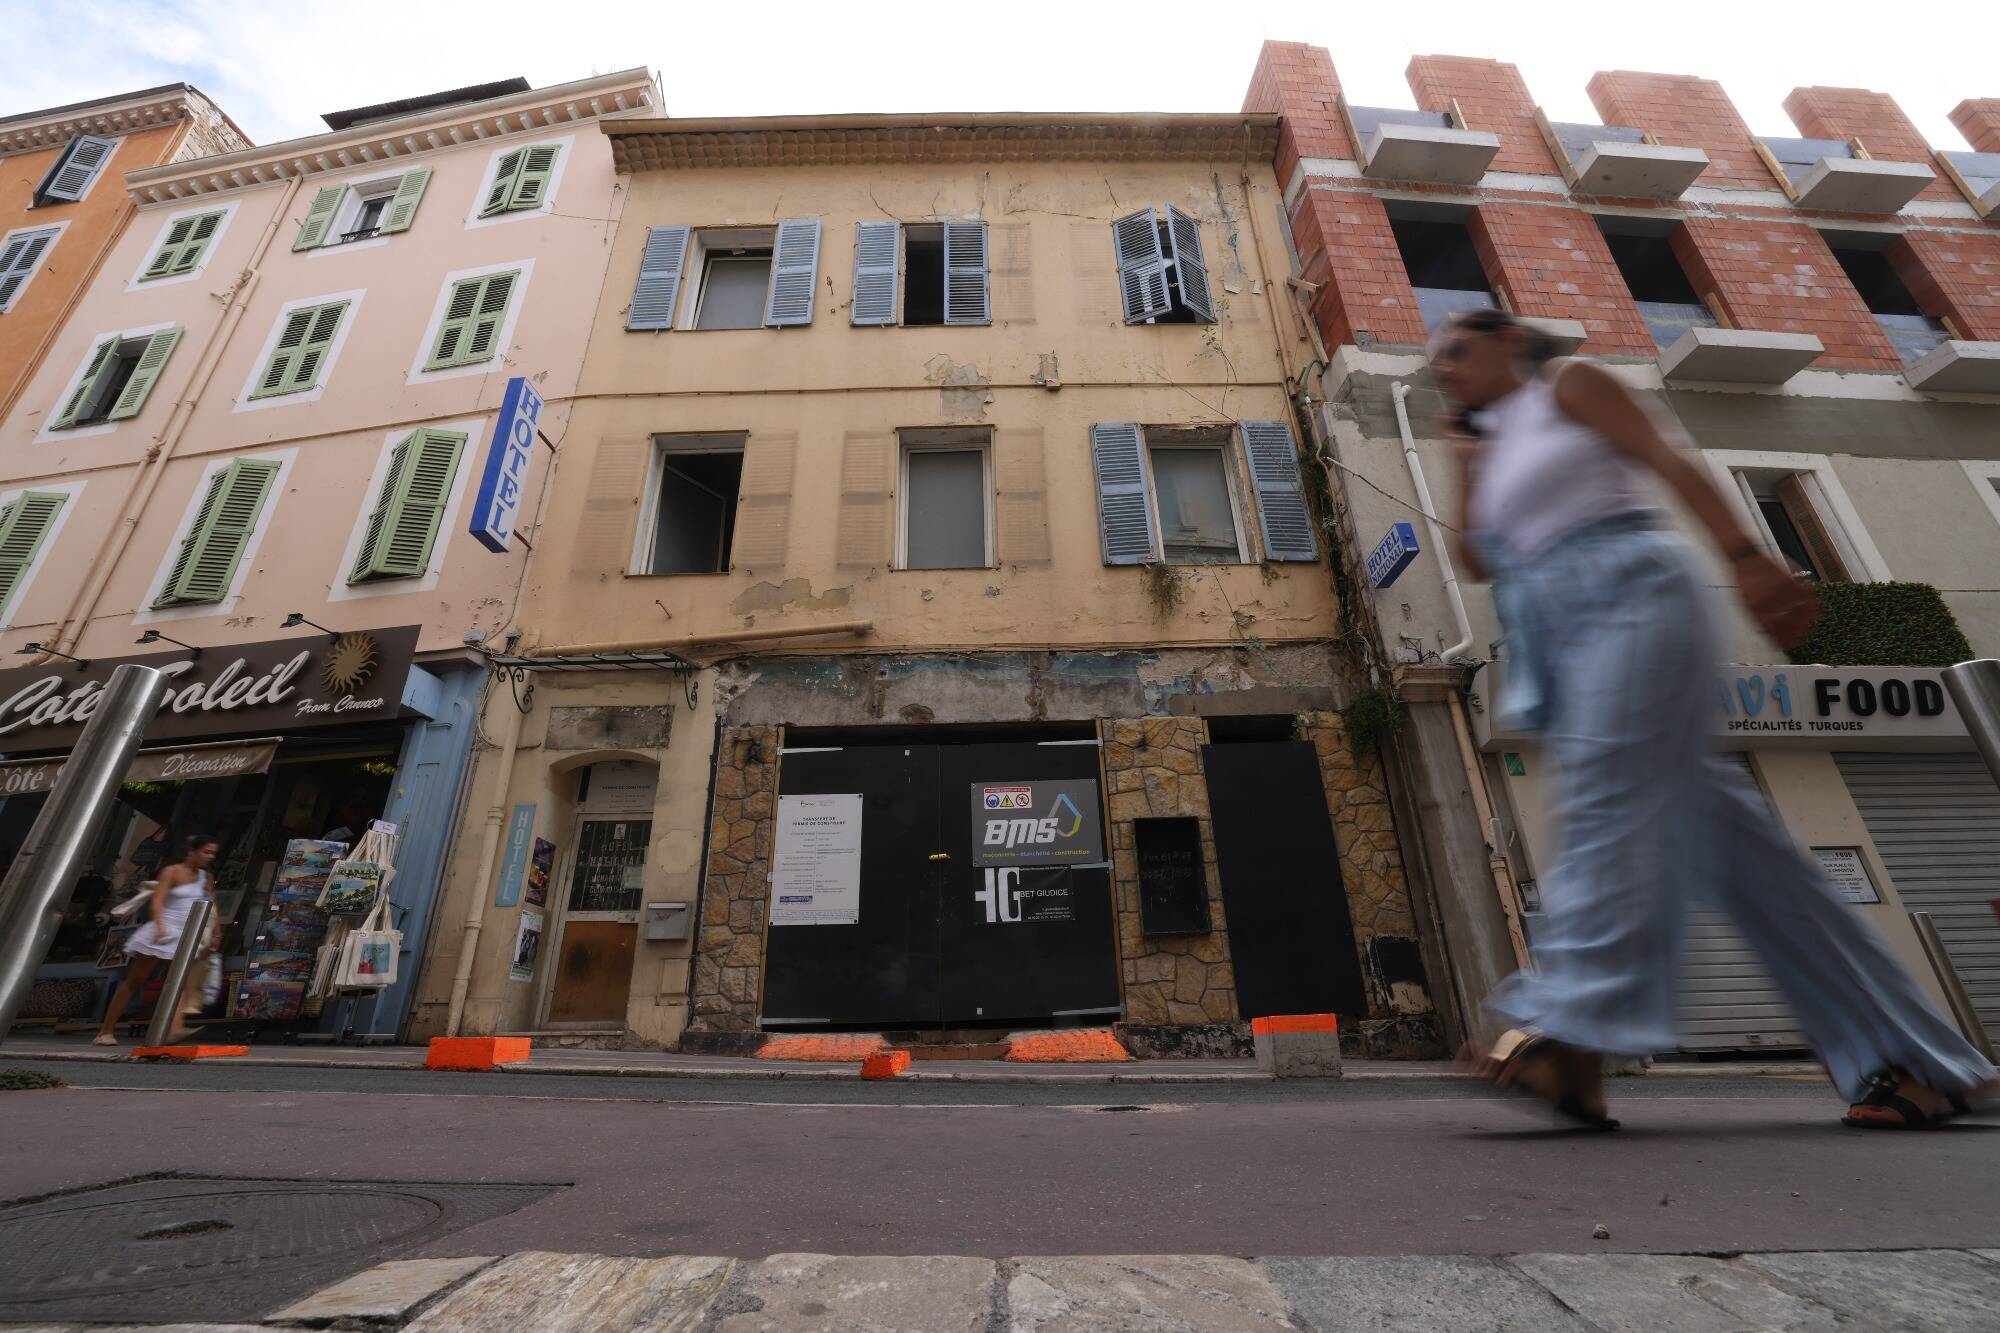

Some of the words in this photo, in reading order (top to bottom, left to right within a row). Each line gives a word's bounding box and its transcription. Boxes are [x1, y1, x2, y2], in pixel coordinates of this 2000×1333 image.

[491, 385, 541, 540] HOTEL
[1368, 531, 1400, 575] HOTEL
[1371, 544, 1404, 584] NATIONAL
[295, 698, 330, 718] From
[1814, 679, 1945, 717] FOOD
[1727, 719, 1802, 731] SPÉCIALITÉS
[1808, 721, 1864, 731] TURQUES
[161, 753, 248, 777] Décoration
[983, 817, 1059, 849] BMS
[503, 810, 529, 900] HOTEL
[1020, 890, 1035, 898] BET
[1036, 889, 1069, 897] GIUDICE
